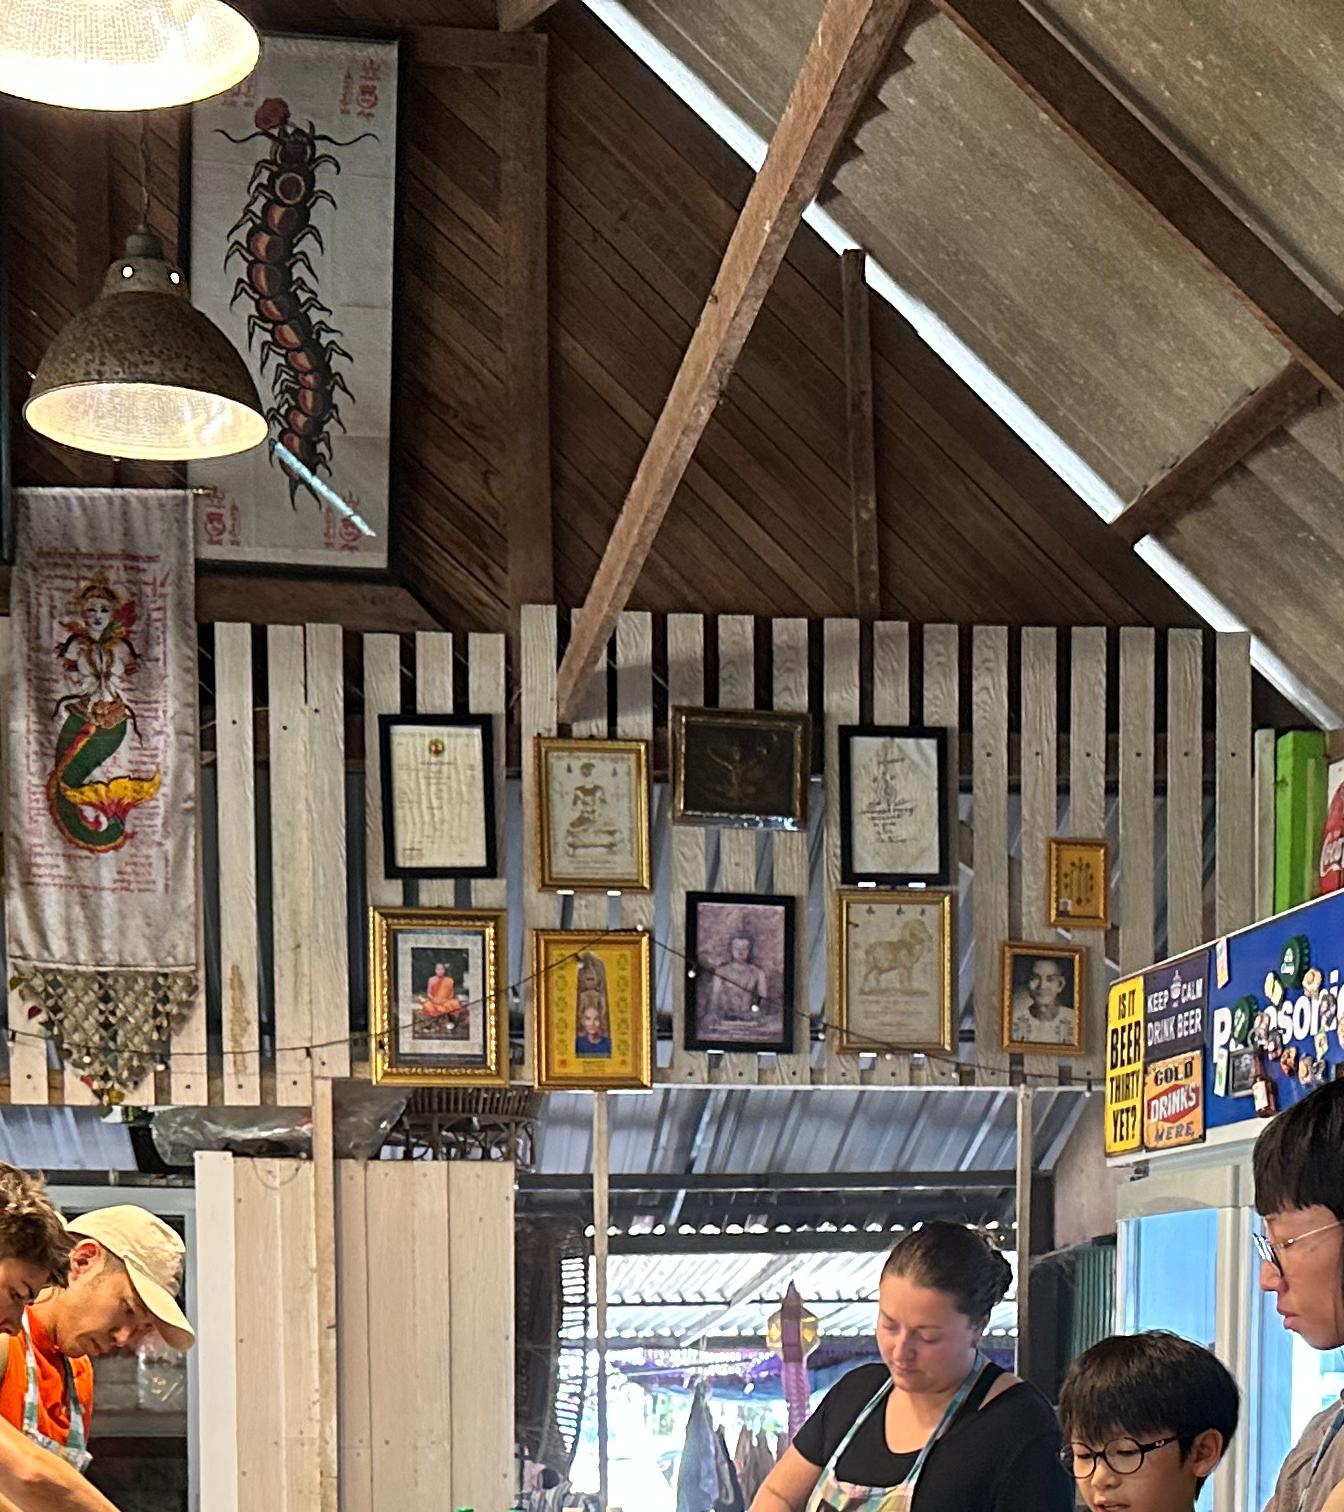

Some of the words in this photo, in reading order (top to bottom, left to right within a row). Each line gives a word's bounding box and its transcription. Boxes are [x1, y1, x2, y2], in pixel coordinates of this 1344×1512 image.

[1118, 992, 1127, 1020] IS
[1128, 988, 1137, 1017] IT
[1147, 989, 1169, 1013] KEEP
[1181, 978, 1203, 1004] CALM
[1109, 1020, 1141, 1071] BEER
[1147, 1015, 1176, 1047] DRINK
[1177, 1008, 1202, 1038] BEER
[1109, 1070, 1140, 1105] THIRTY
[1150, 1083, 1197, 1122] DRINKS
[1112, 1105, 1137, 1143] YET?
